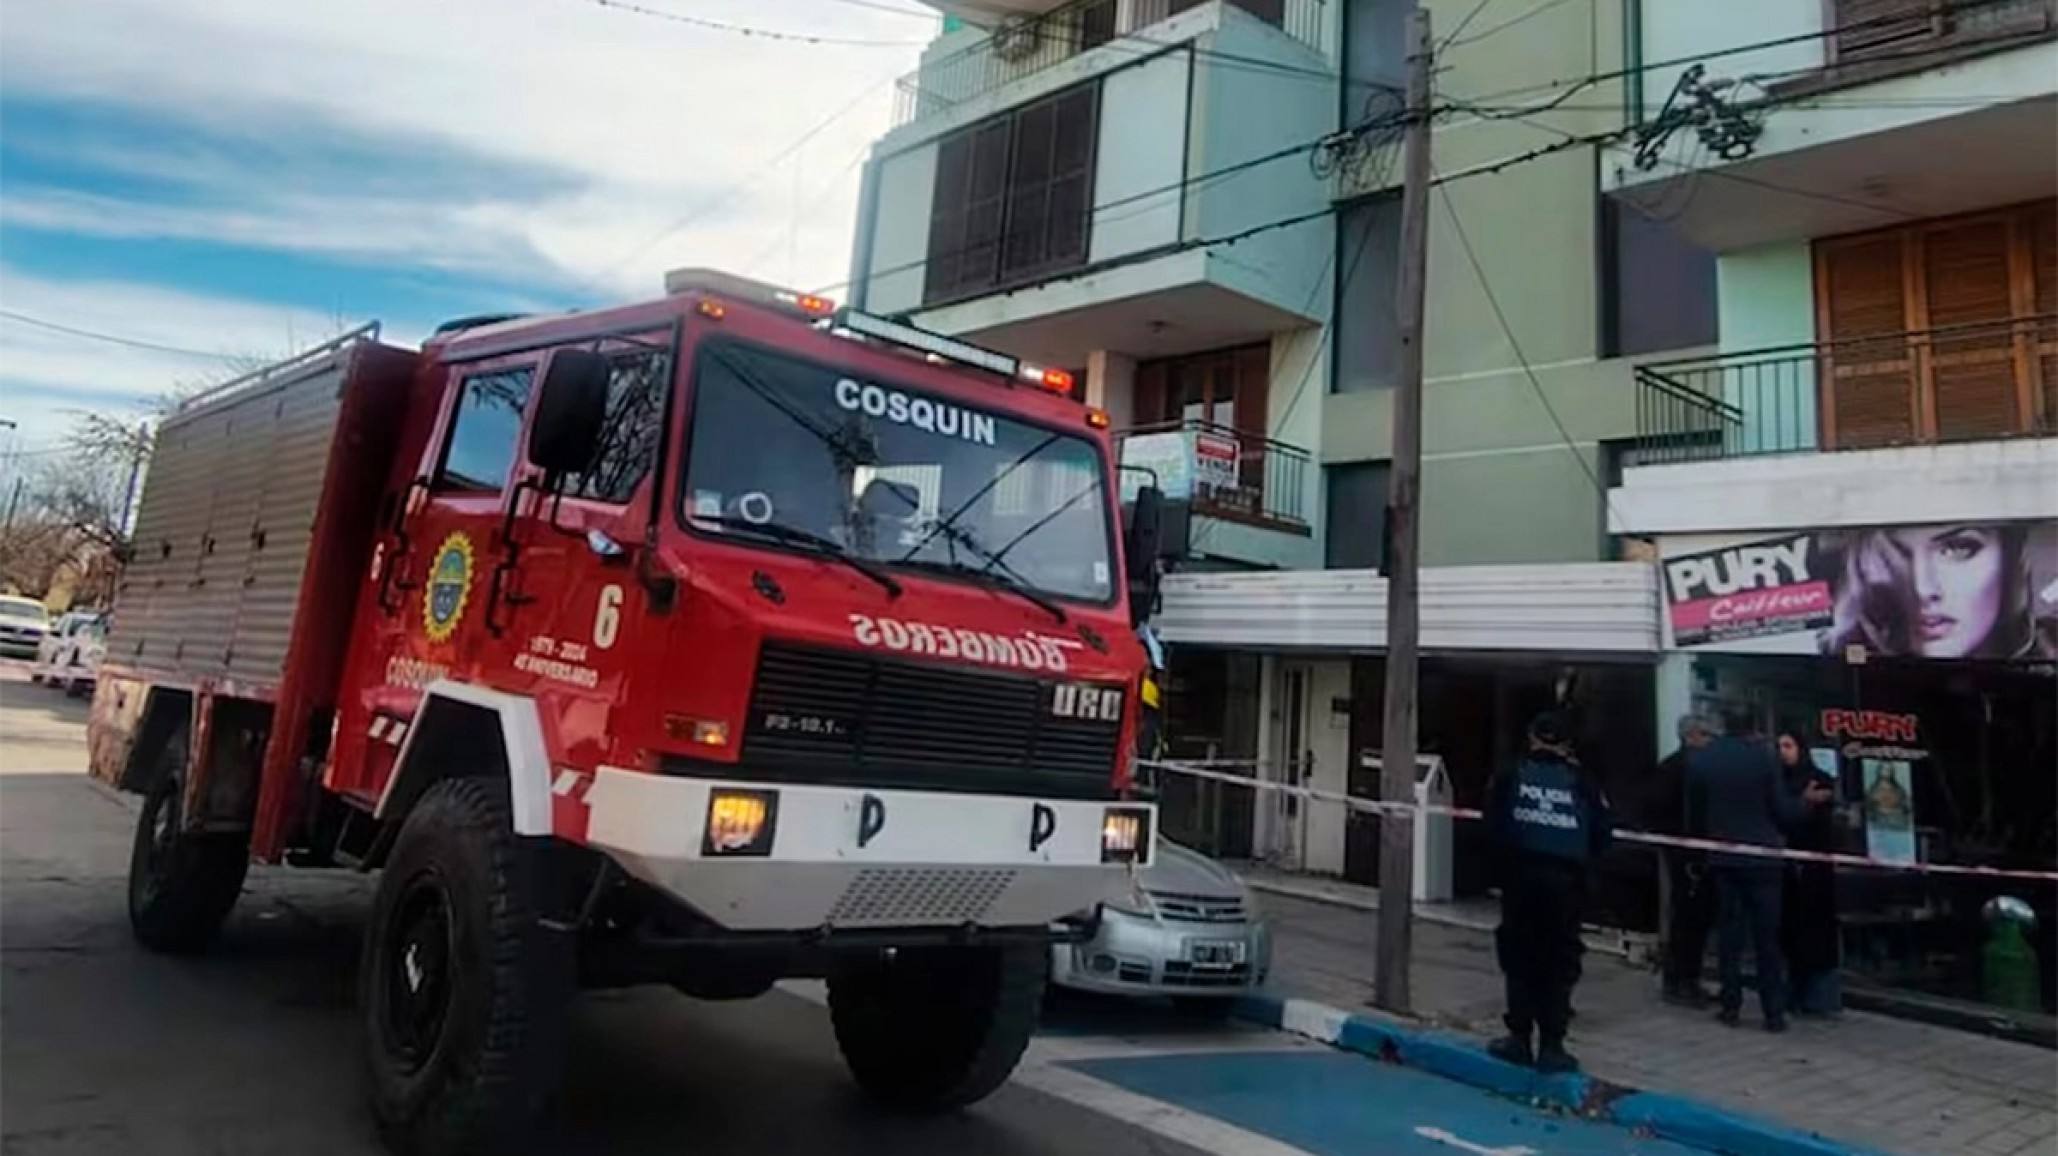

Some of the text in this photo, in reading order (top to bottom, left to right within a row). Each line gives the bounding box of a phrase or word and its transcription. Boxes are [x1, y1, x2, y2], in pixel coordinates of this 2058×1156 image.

[834, 377, 998, 446] COSQUIN
[1666, 536, 1812, 601] PURY
[593, 584, 624, 650] 6
[1052, 683, 1123, 721] URO
